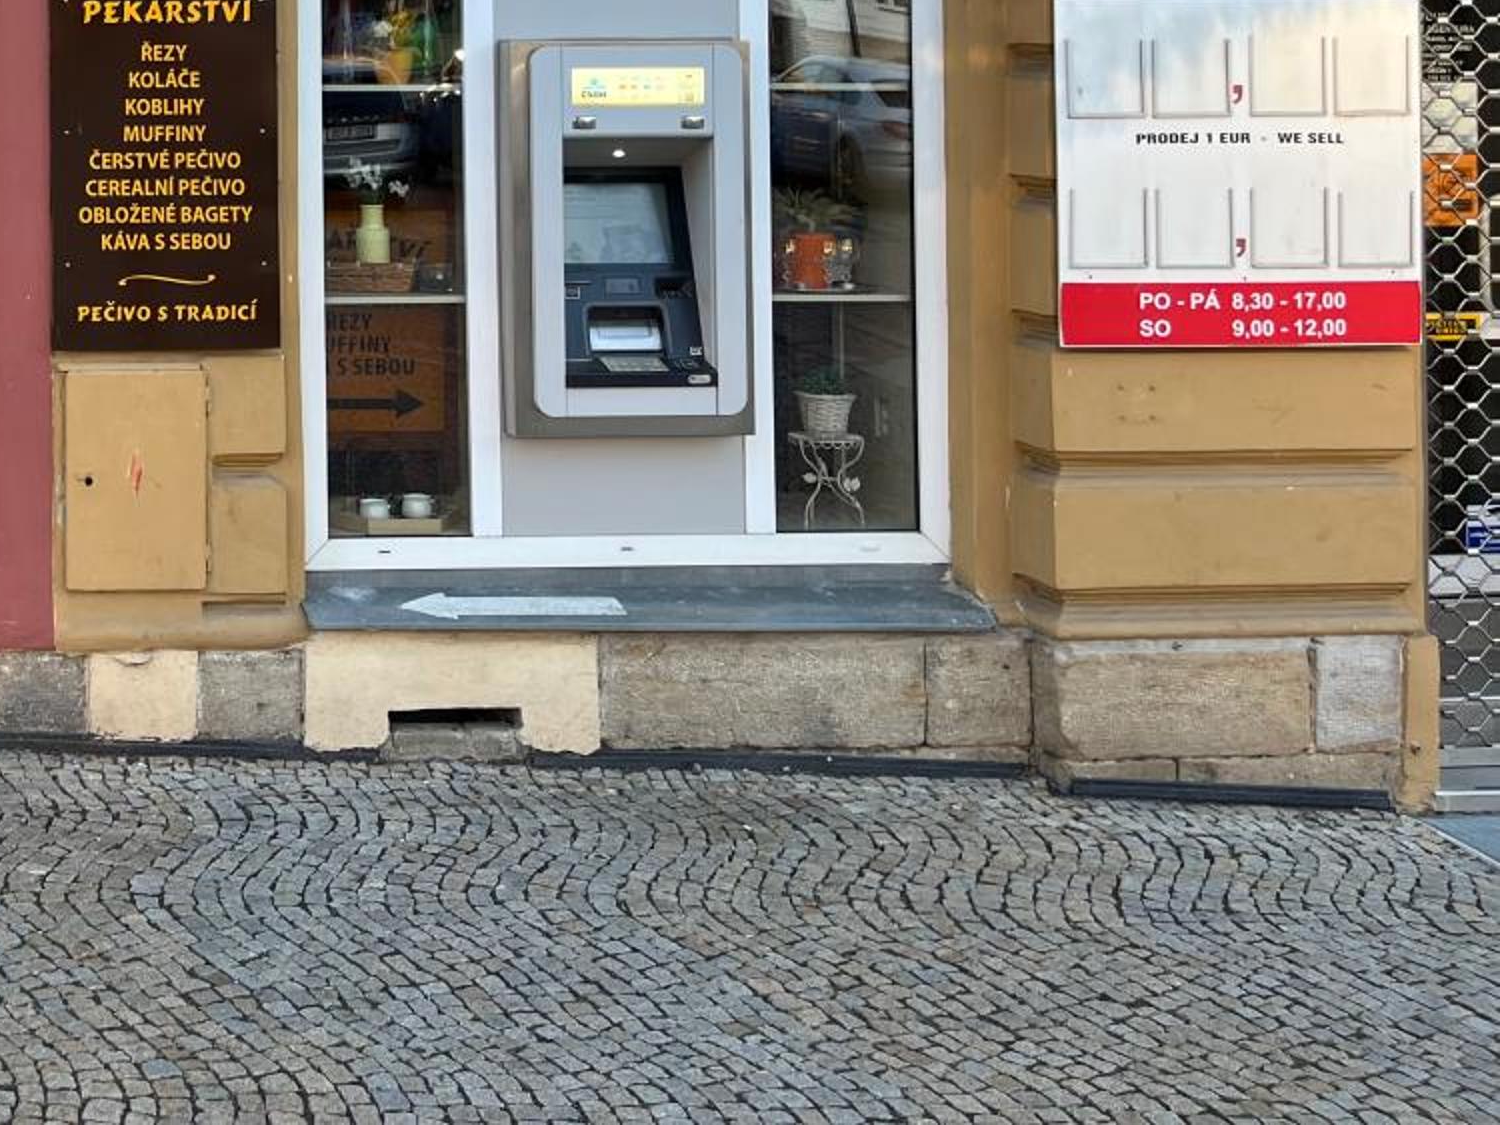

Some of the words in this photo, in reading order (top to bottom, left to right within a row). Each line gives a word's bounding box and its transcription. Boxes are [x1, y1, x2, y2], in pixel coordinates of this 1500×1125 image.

[141, 41, 187, 62] ŘEZY
[128, 68, 201, 89] KOLÁČE
[125, 98, 205, 116] KOBLIHY
[123, 124, 207, 142] MUFFINY
[1135, 132, 1199, 145] PRODEJ
[1206, 132, 1213, 144] 1
[1219, 132, 1251, 144] EUR
[1277, 132, 1302, 144] WE
[1307, 132, 1344, 144] SELL
[89, 148, 170, 170] ČERSTVÉ
[174, 148, 241, 169] PEČIVO
[85, 175, 174, 197] CEREALNÍ
[178, 175, 245, 196] PEČIVO
[78, 202, 177, 224] OBLOŽENÉ
[180, 205, 253, 224] BAGETY
[101, 230, 151, 251] KÁVA
[155, 232, 166, 251] S
[169, 232, 231, 250] SEBOU
[77, 300, 151, 322] PEČIVO
[157, 305, 168, 322] S
[173, 298, 258, 322] TRADICÍ
[1139, 292, 1171, 310] PO
[1190, 288, 1221, 310] PÁ
[1231, 292, 1274, 312] 8,30
[1293, 291, 1347, 312] 17,00
[1139, 319, 1172, 338] SO
[1231, 319, 1275, 339] 9,00
[1293, 319, 1348, 340] 12,00
[352, 356, 417, 375] SEBOU
